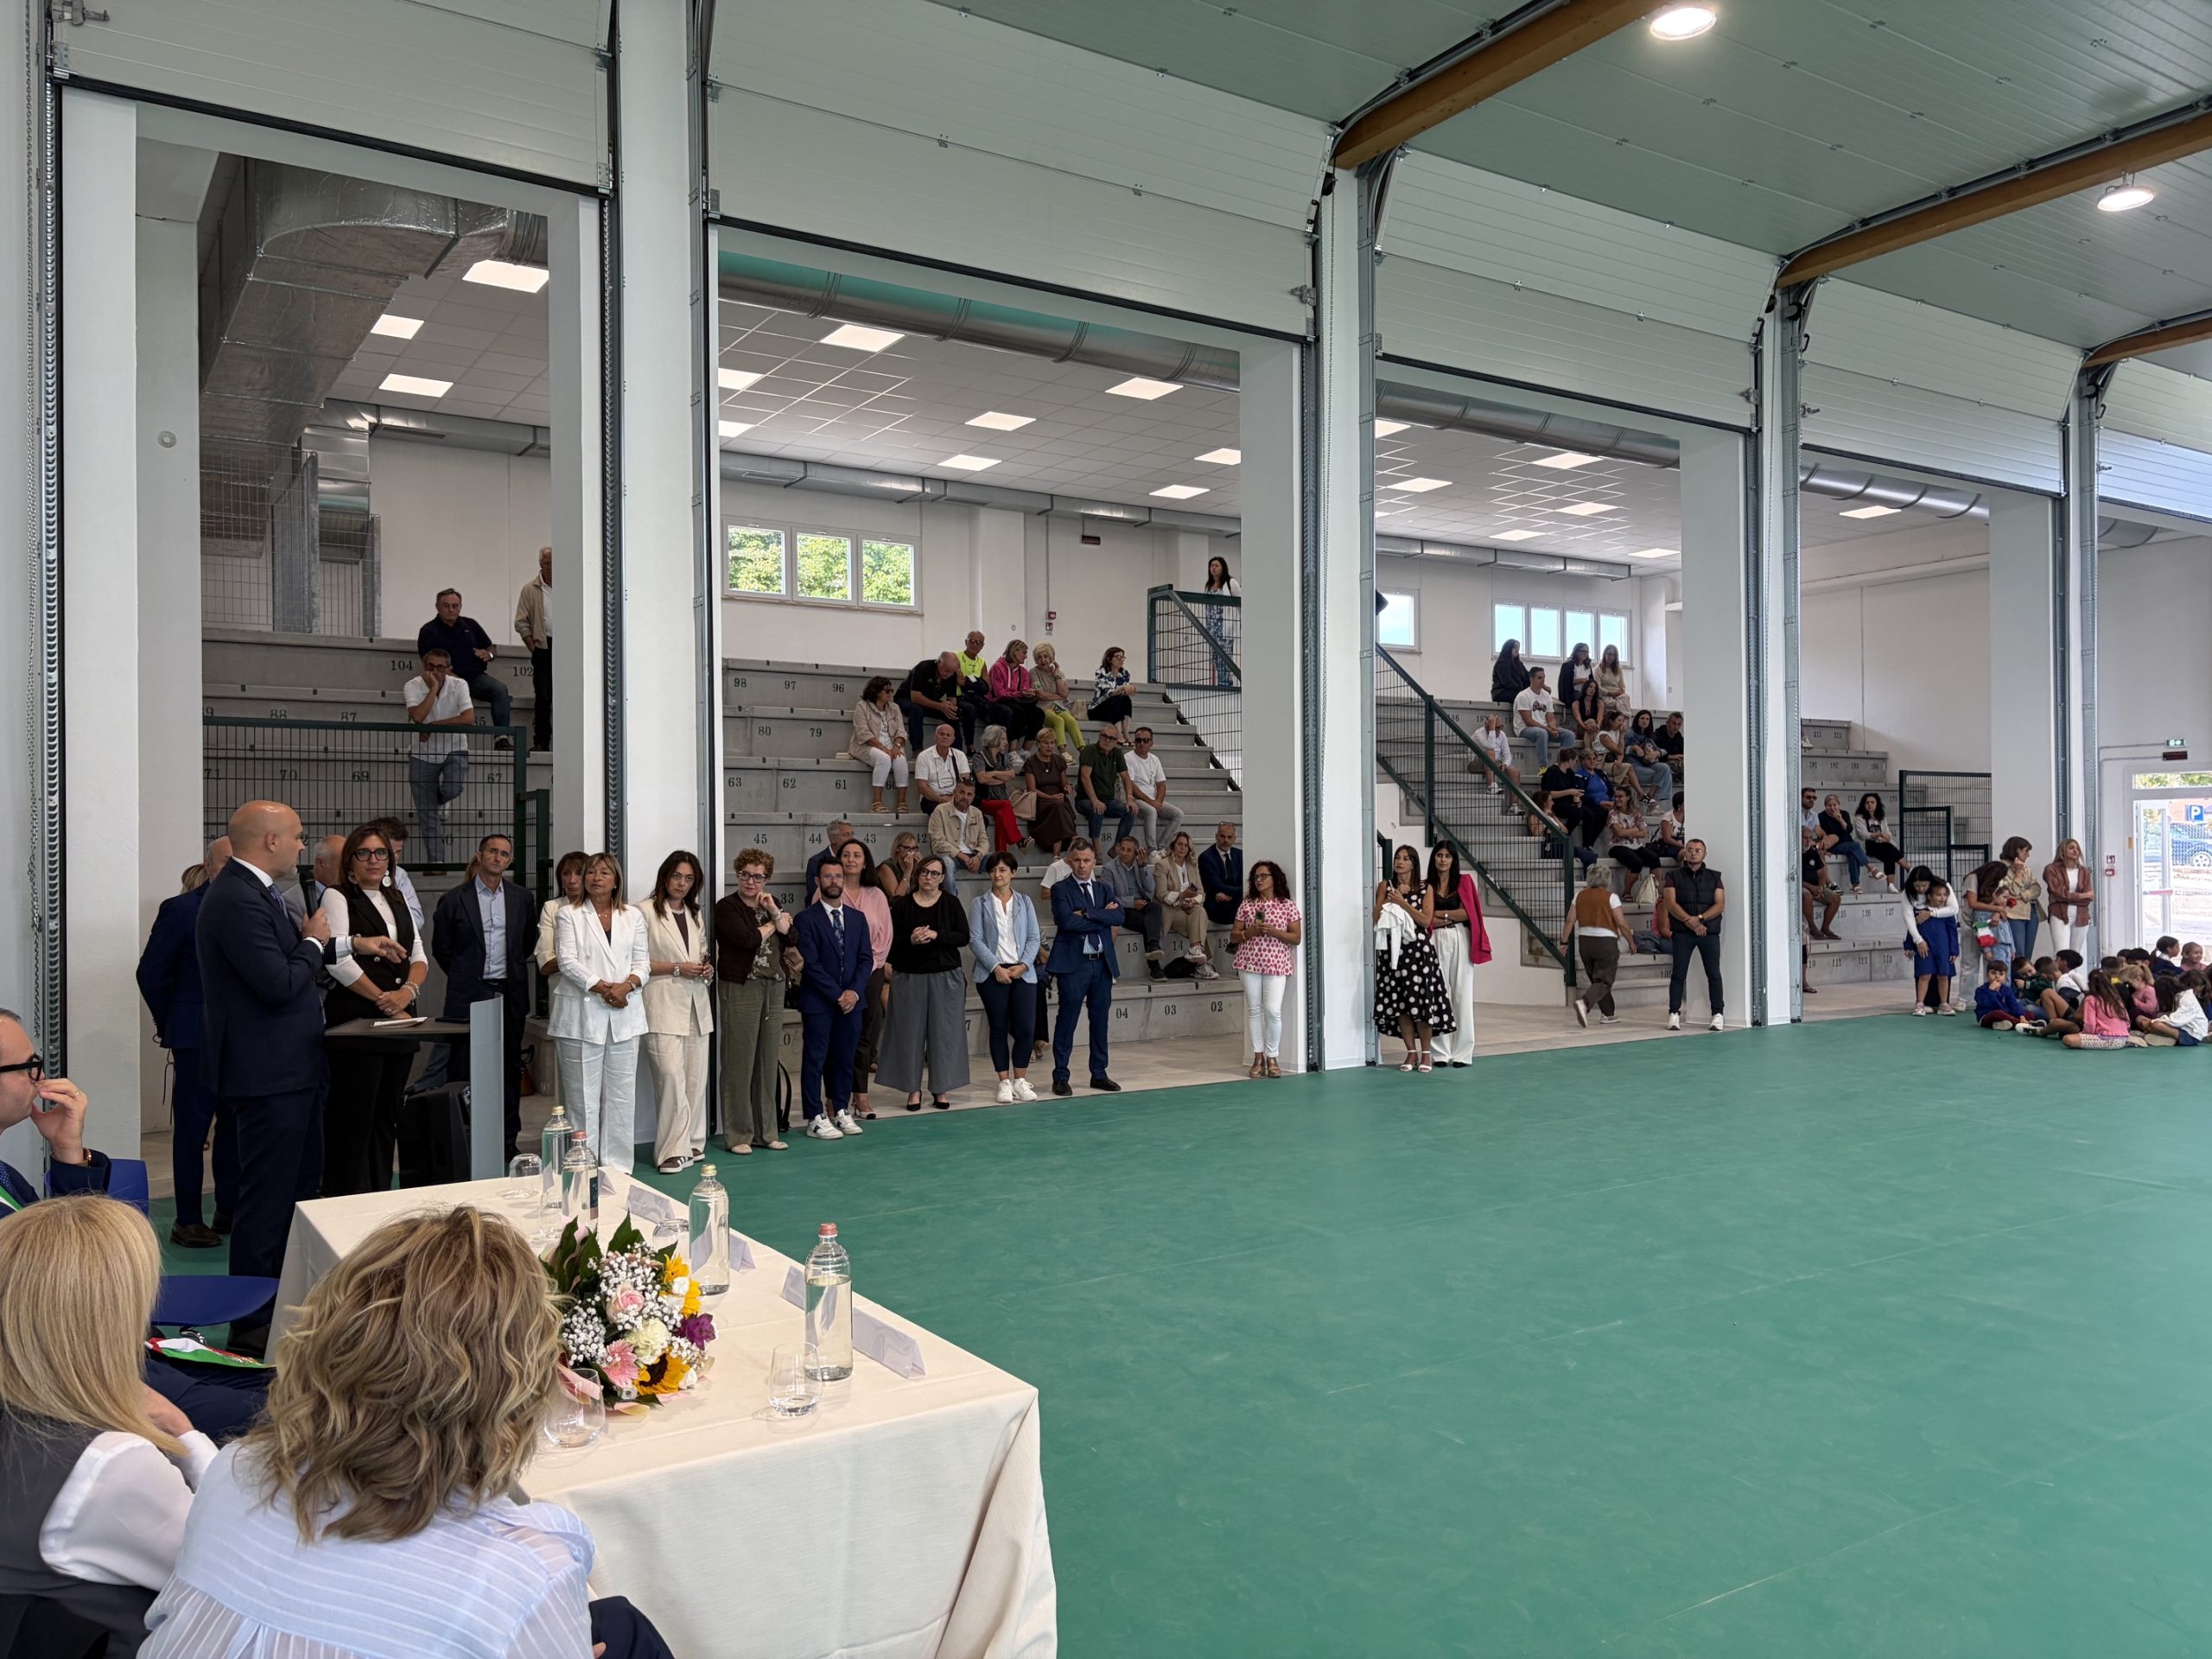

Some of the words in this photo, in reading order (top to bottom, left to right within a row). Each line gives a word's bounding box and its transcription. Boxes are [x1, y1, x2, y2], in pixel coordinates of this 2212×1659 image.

[391, 660, 413, 671] 104
[513, 666, 533, 677] 102
[734, 677, 747, 688] 98
[784, 680, 797, 690] 97
[832, 683, 845, 693] 96
[203, 706, 214, 718] 9
[270, 709, 287, 719] 88
[341, 712, 357, 721] 87
[758, 726, 772, 736] 80
[810, 728, 822, 738] 79
[280, 769, 297, 781] 70
[353, 771, 369, 782] 69
[487, 772, 502, 784] 67
[728, 778, 742, 788] 63
[783, 779, 797, 789] 62
[835, 779, 848, 790] 61
[2190, 806, 2201, 820] P
[753, 833, 767, 844] 45
[809, 833, 823, 844] 44
[864, 833, 876, 843] 43
[1101, 832, 1112, 842] 38
[780, 893, 794, 905] 33
[1127, 942, 1138, 952] 15
[1173, 940, 1183, 950] 14
[1217, 938, 1229, 949] 13
[1164, 1004, 1177, 1015] 03
[1211, 1001, 1224, 1012] 02
[1116, 1007, 1128, 1019] 04
